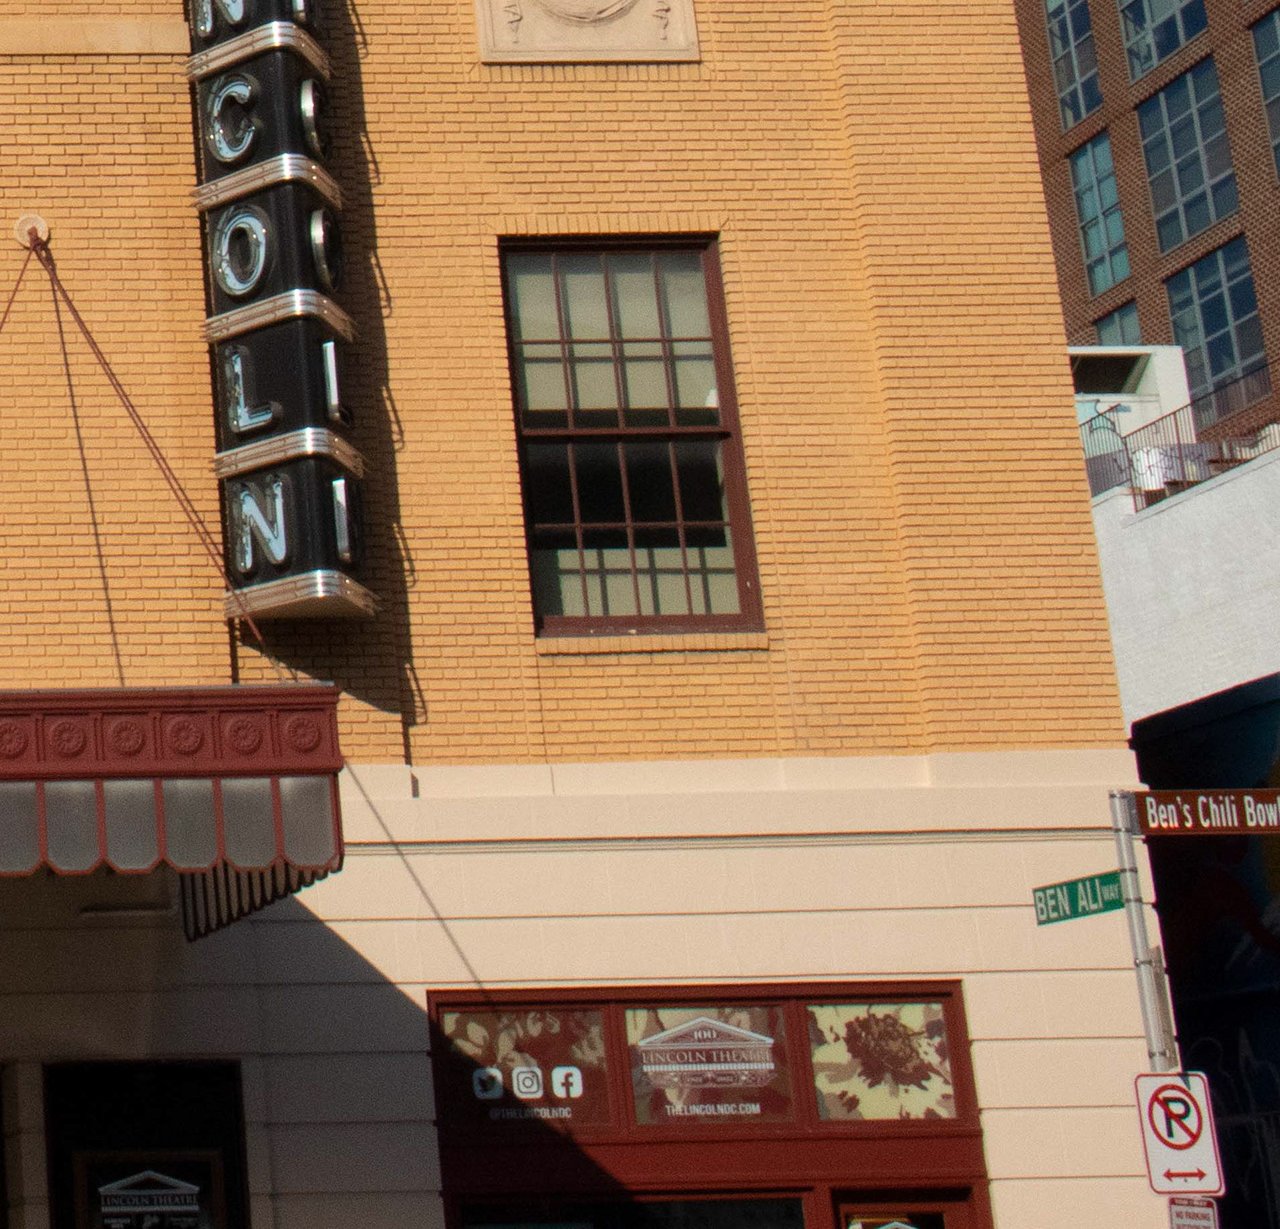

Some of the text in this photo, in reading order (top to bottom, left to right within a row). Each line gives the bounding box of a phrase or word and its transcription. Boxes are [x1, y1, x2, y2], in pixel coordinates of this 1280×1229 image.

[1145, 795, 1193, 829] Ben's
[1197, 794, 1239, 828] Chili
[1035, 879, 1120, 921] BEN ALI WAY
[642, 1050, 773, 1063] LINCOLN THEATRE
[665, 1103, 761, 1115] THELINCOLNDC.COM
